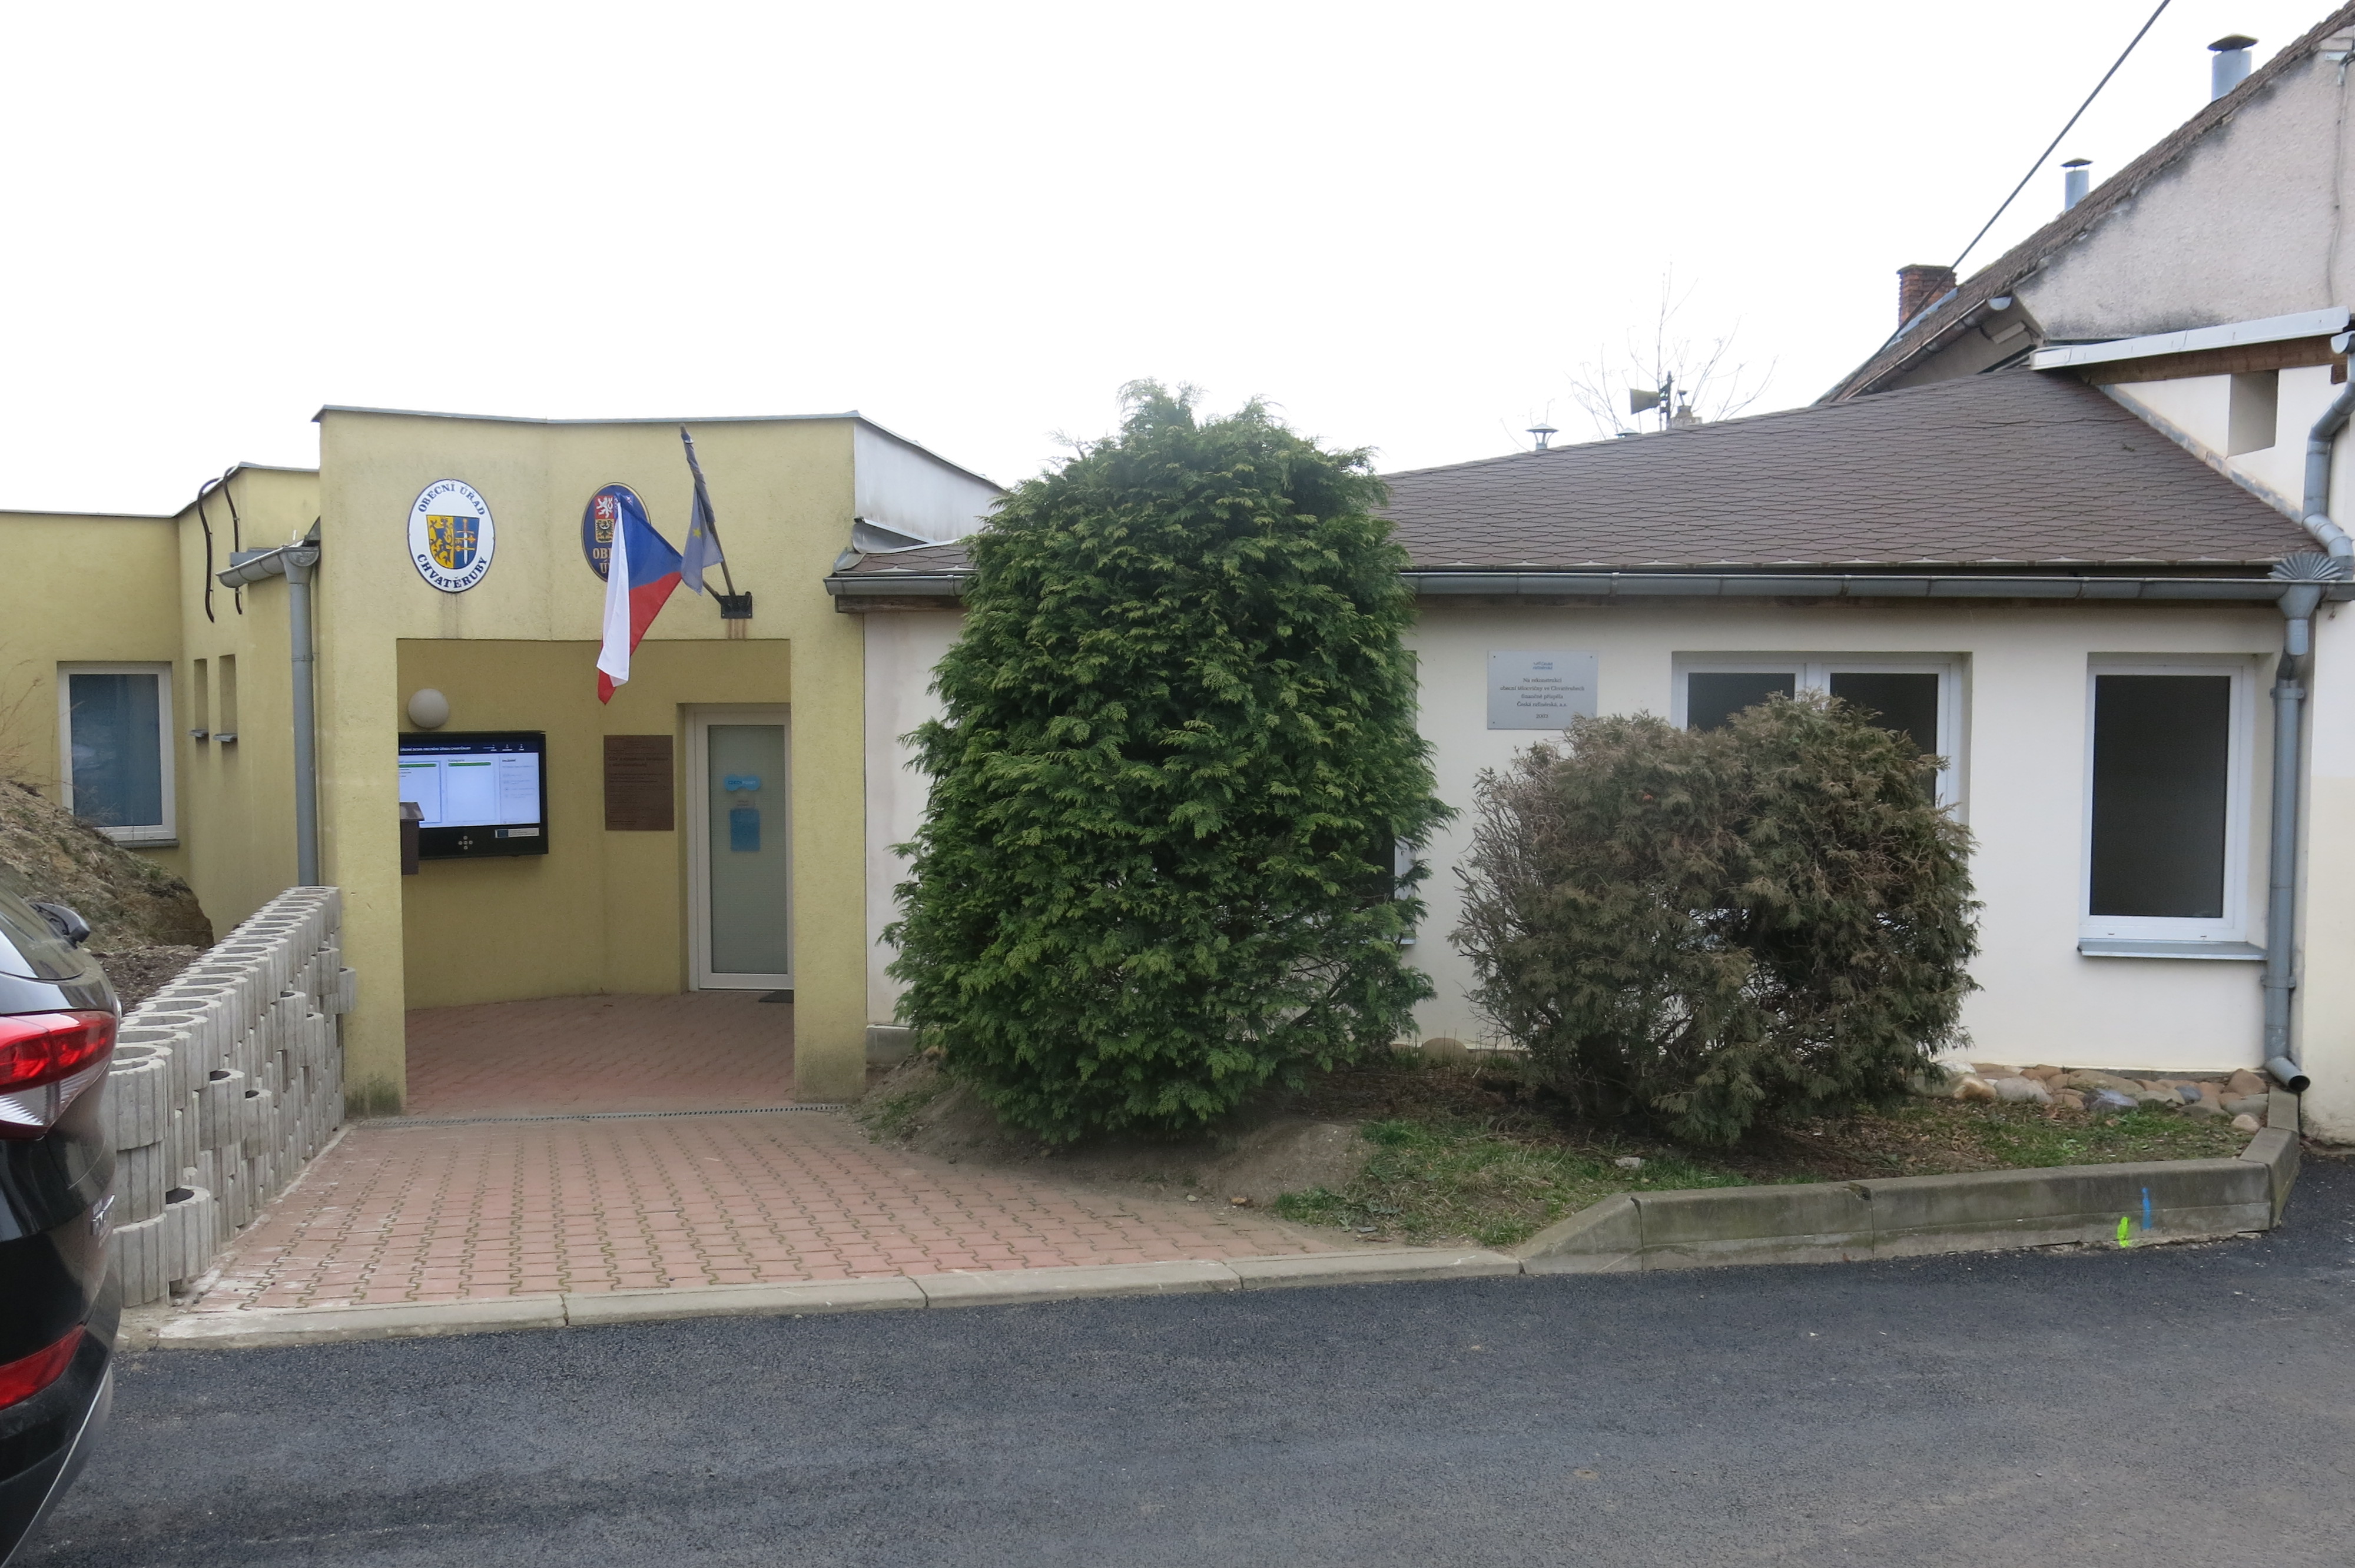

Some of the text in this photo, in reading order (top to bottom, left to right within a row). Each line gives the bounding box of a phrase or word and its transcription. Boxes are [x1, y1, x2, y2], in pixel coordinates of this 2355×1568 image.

[418, 481, 485, 515] OBECNÍ ÚŘAD
[417, 554, 487, 589] CHVATĚRUBY
